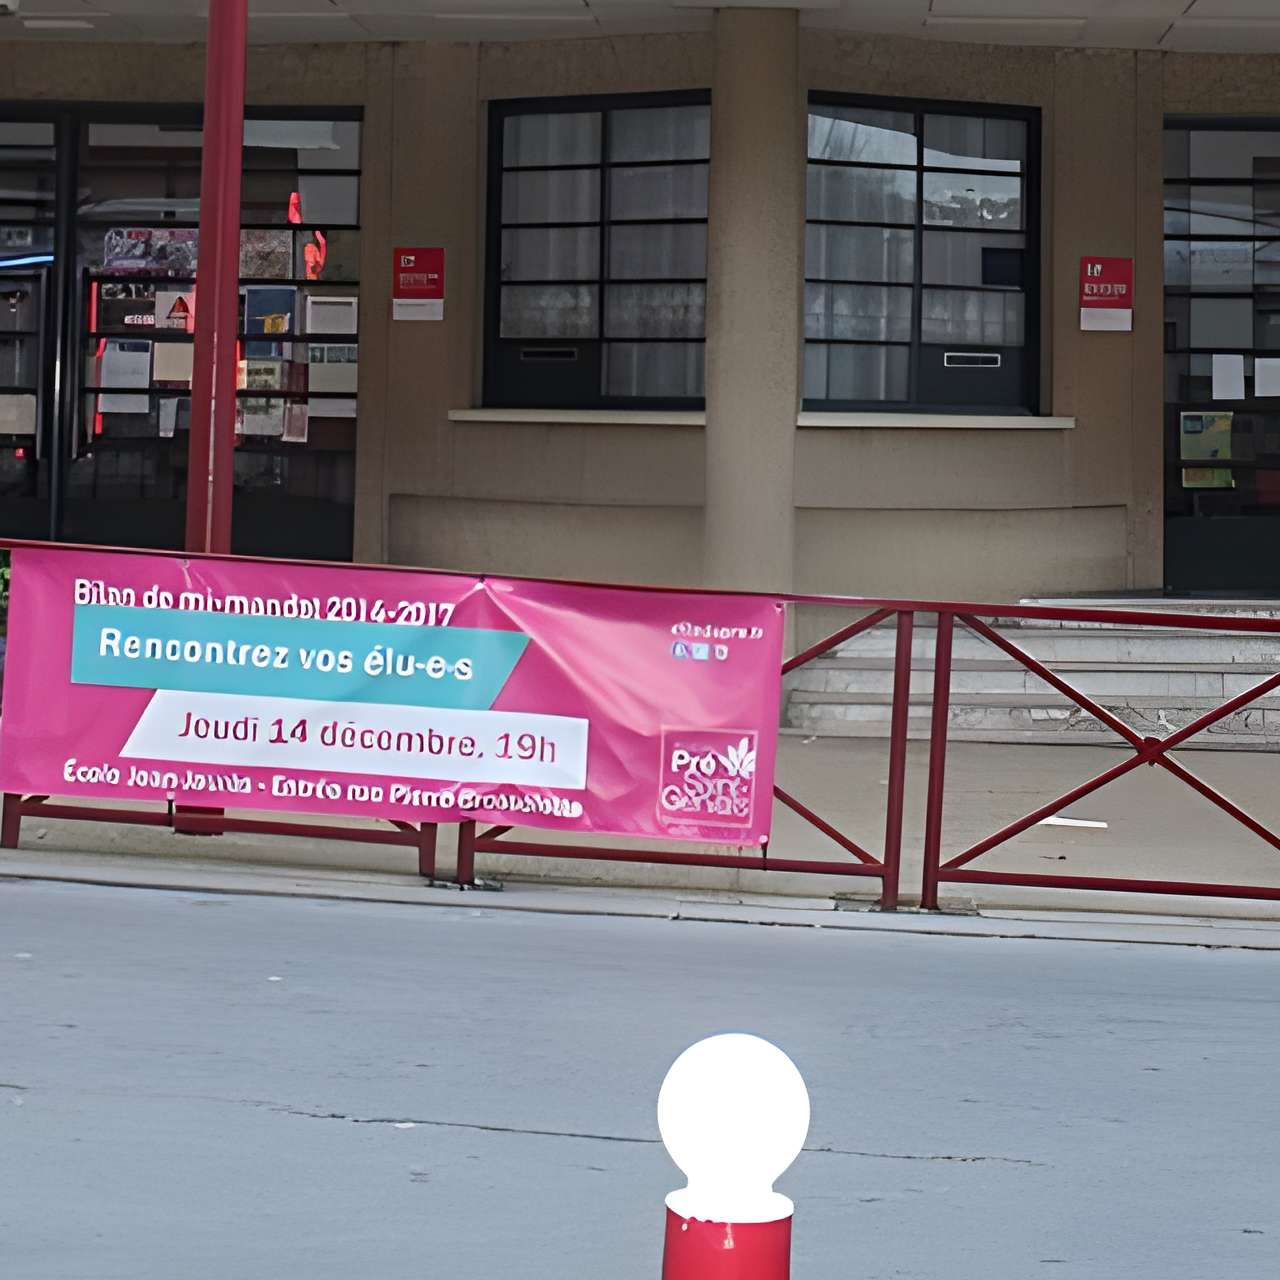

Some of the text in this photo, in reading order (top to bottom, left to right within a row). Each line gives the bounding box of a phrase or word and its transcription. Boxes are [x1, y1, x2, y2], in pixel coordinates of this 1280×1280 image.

[299, 648, 353, 673] vos
[269, 718, 307, 744] 14
[496, 732, 556, 763] 19h
